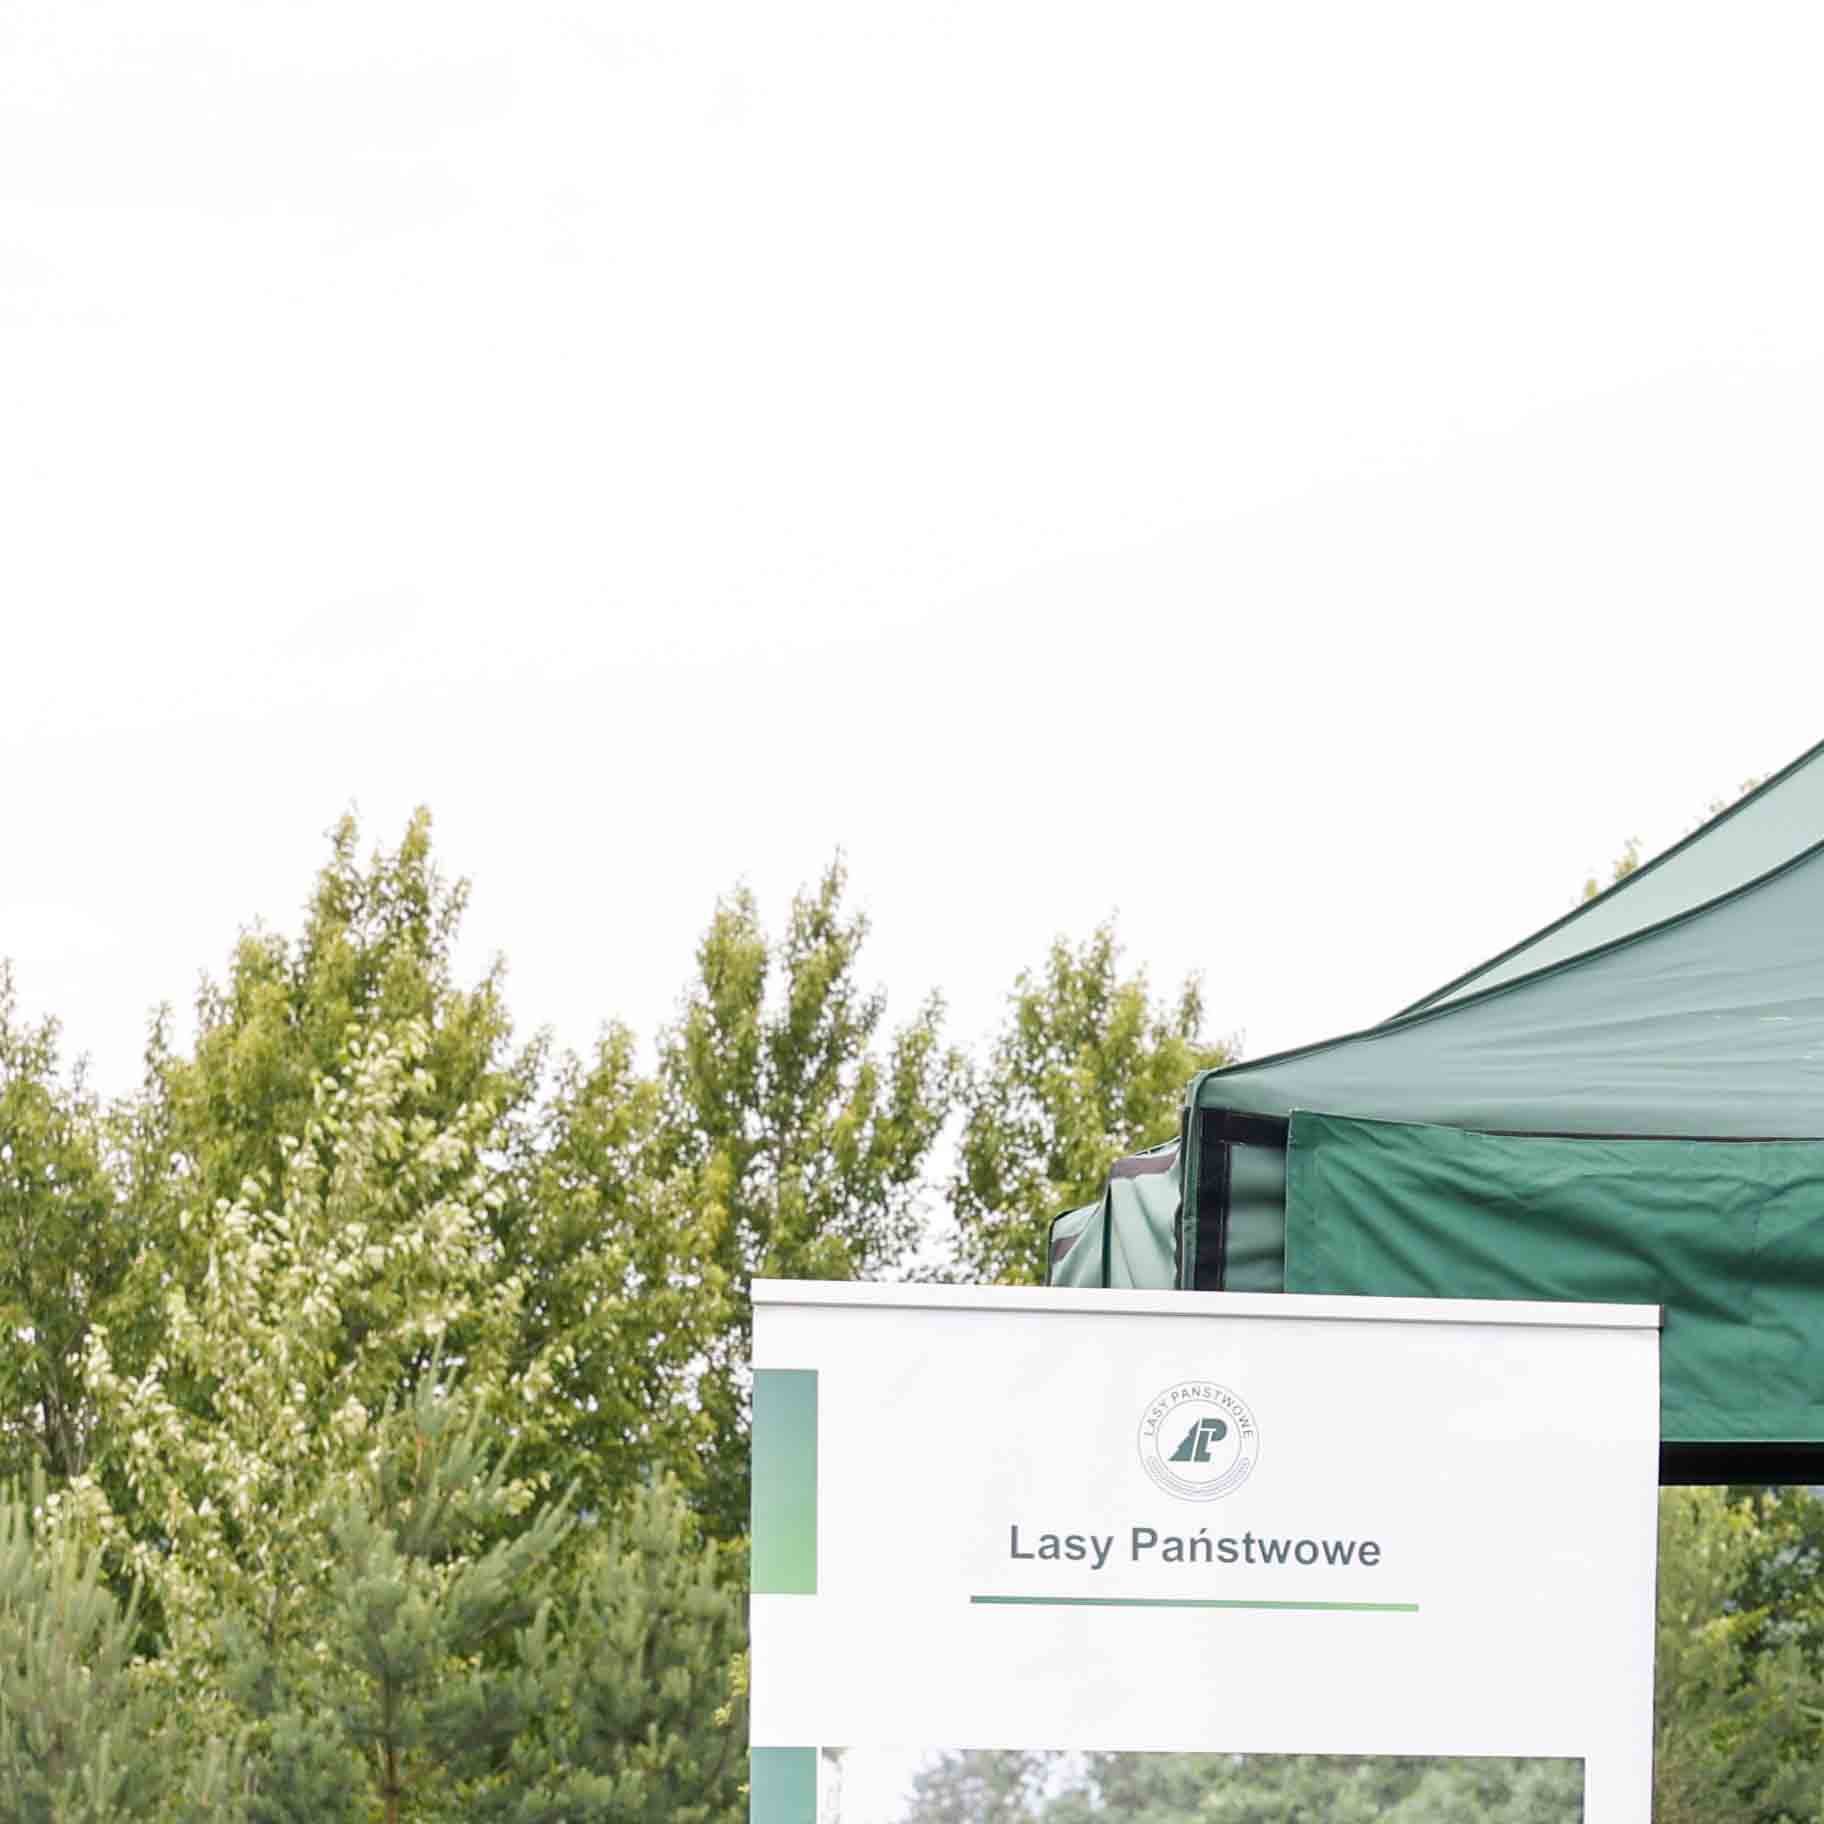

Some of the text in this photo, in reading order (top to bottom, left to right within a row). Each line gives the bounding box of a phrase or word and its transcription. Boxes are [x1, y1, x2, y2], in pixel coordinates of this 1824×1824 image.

[1143, 1397, 1169, 1438] LASY
[1010, 1524, 1382, 1570] Lasy Państwowe
